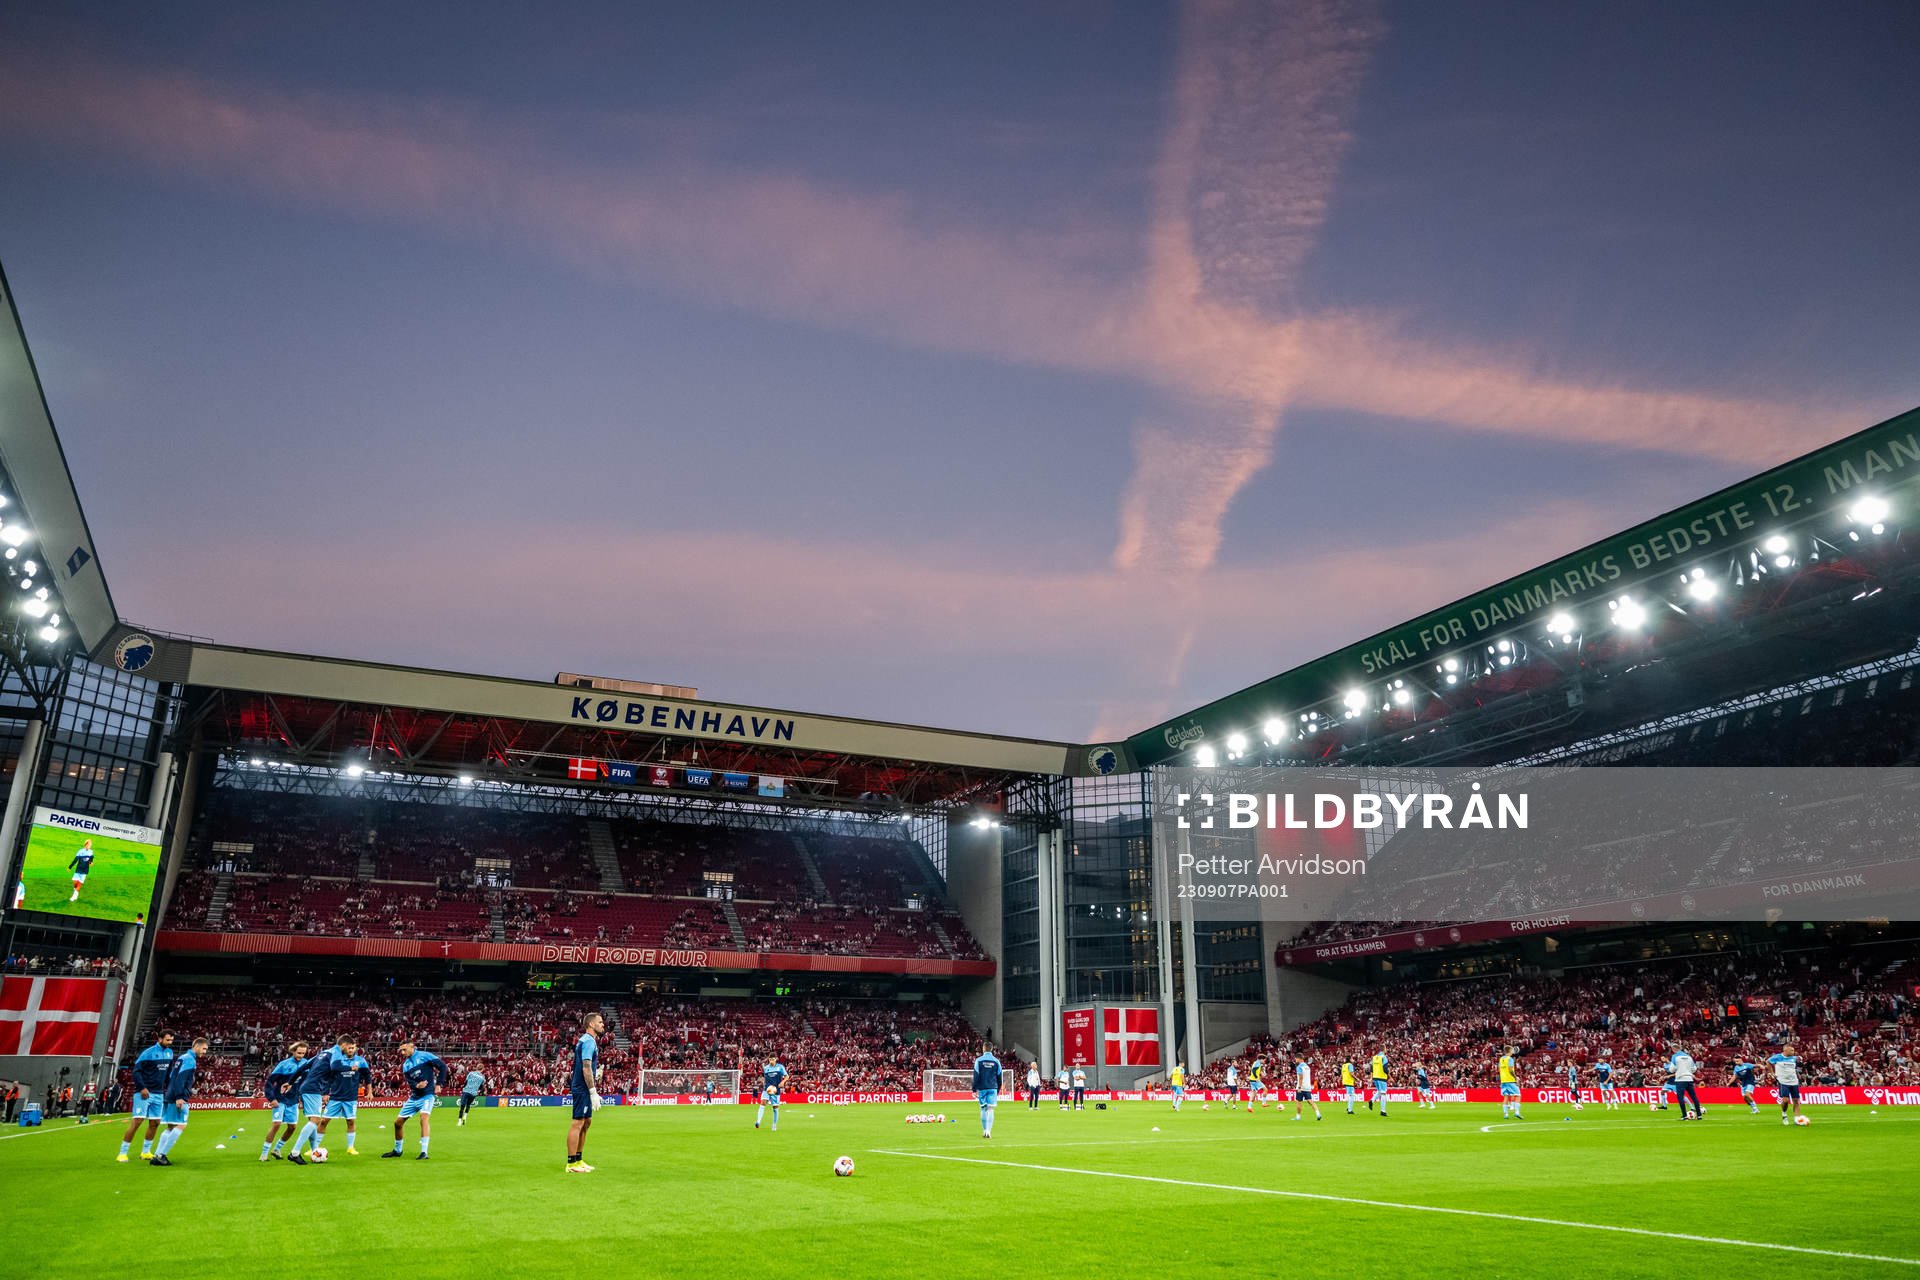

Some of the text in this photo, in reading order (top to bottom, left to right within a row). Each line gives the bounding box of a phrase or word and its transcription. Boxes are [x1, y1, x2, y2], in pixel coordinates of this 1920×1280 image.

[1361, 639, 1417, 674] SKÅL
[1419, 617, 1467, 652] FOR
[1470, 555, 1621, 632] DANMARKS
[1628, 501, 1755, 570] BEDSTE
[1761, 484, 1813, 518] 12.
[571, 696, 794, 741] KØBENHAVN
[1164, 724, 1205, 749] Carlsberg
[611, 768, 632, 778] FIFA
[687, 774, 709, 785] UEFA
[729, 780, 749, 788] RESPECT
[50, 813, 100, 832] PARKEN
[1762, 873, 1866, 898] FOR DANMARK
[1511, 914, 1570, 932] FOR HOLDET
[543, 946, 707, 967] DEN RØDE MUR
[1316, 941, 1386, 958] FOR AT STÅ SAMMEN
[508, 1098, 541, 1106] STARK
[807, 1093, 908, 1104] OFFICIEL PARTNER
[1433, 1090, 1467, 1102] hummel
[1790, 1089, 1846, 1104] ummel
